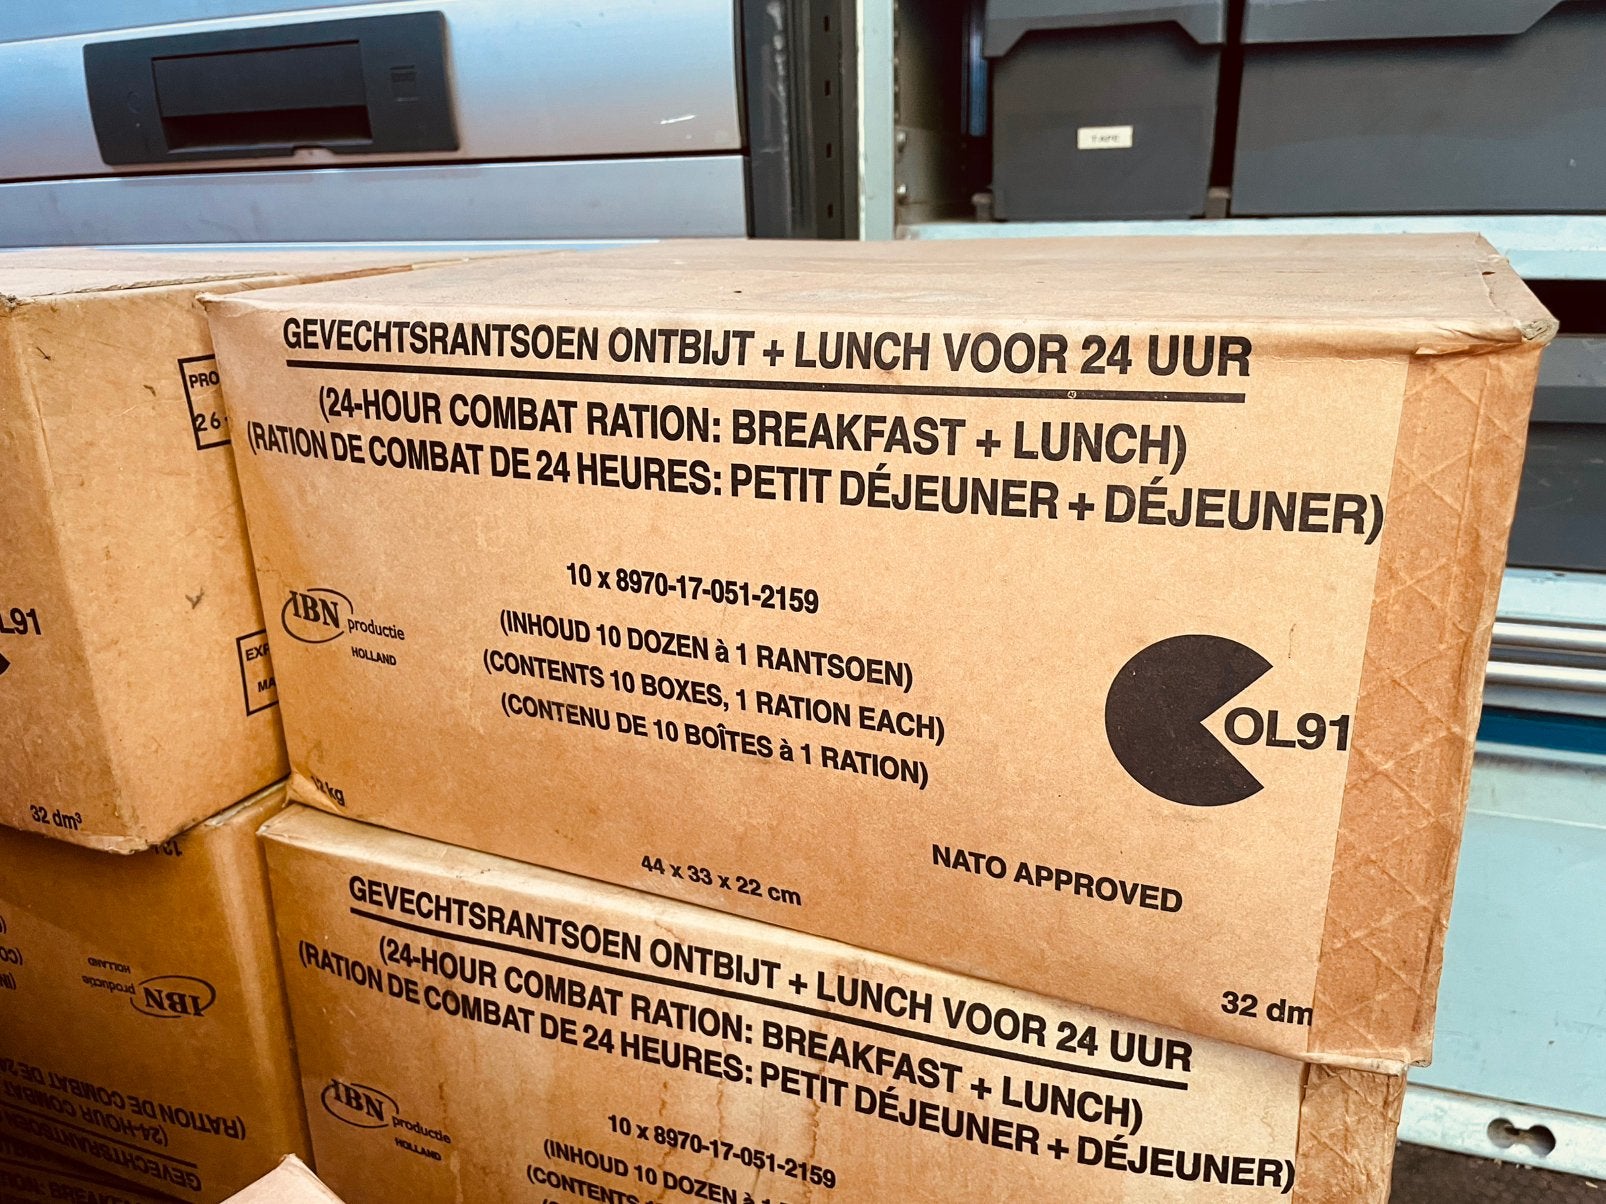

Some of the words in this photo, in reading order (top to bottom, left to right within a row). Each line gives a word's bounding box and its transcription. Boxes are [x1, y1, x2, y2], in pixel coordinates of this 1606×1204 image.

[283, 317, 598, 360] GEVECHTSRANTSOEN
[608, 327, 754, 366] ONTBIJT
[763, 338, 784, 366] +
[796, 331, 930, 371] LUNCH
[943, 333, 1066, 374] VOOR
[1081, 335, 1132, 375] 24
[1147, 335, 1252, 377] UUR
[319, 386, 441, 424] (24-HOUR
[449, 393, 577, 433] COMBAT
[587, 402, 721, 443] RATION:
[732, 409, 966, 455] BREAKFAST
[976, 429, 1001, 457] +
[1015, 420, 1186, 474] LUNCH)
[247, 420, 329, 460] (RATION
[332, 433, 363, 463] DE
[369, 434, 484, 475] COMBAT
[491, 447, 531, 479] DE
[536, 450, 570, 483] 24
[577, 451, 722, 495] HEURES:
[732, 463, 832, 503] PETIT
[839, 463, 1057, 519] DÉJEUNER
[1069, 493, 1095, 521] +
[1105, 476, 1384, 544] DÉJEUNER)
[567, 563, 591, 587] 10
[597, 572, 611, 590] x
[616, 568, 819, 614] 8970-17-051-2159
[289, 590, 341, 629] IBN
[347, 617, 406, 641] productie
[351, 645, 397, 666] HOLLAND
[500, 609, 590, 643] (INHOUD
[596, 624, 621, 648] 10
[627, 627, 708, 660] DOZEN
[715, 639, 729, 663] à
[735, 643, 745, 665] 1
[756, 644, 912, 692] RANTSOEN)
[483, 648, 605, 688] (CONTENTS
[610, 669, 635, 693] 10
[641, 674, 729, 712] BOXES,
[736, 689, 746, 710] 1
[756, 695, 851, 727] RATION
[859, 707, 944, 746] EACH)
[501, 692, 610, 730] (CONTENU
[617, 713, 648, 738] DE
[653, 719, 679, 743] 10
[685, 723, 773, 758] BOÎTES
[779, 738, 794, 762] à
[800, 743, 811, 764] 1
[821, 746, 928, 789] RATION)
[1224, 707, 1350, 751] OL91
[325, 782, 345, 807] kg
[30, 805, 50, 826] 32
[640, 855, 665, 876] 44
[670, 864, 683, 879] x
[687, 864, 713, 885] 33
[718, 874, 731, 890] x
[735, 876, 762, 896] 22
[768, 886, 802, 906] cm
[932, 844, 1006, 879] NATO
[1014, 862, 1182, 913] APPROVED
[82, 975, 136, 995] productie
[87, 957, 131, 974] HOLLAND
[349, 876, 641, 961] GEVECHTSRANTSOEN
[650, 938, 781, 990] ONTBIJT
[789, 972, 808, 995] +
[817, 971, 932, 1024] LUNCH
[943, 997, 1046, 1047] VOOR
[1056, 1021, 1099, 1056] 24
[1110, 1029, 1193, 1072] UUR
[144, 987, 205, 1017] IBN
[1220, 991, 1257, 1018] 32
[379, 935, 496, 988] (24-HOUR
[504, 966, 623, 1017] COMBAT
[631, 994, 753, 1044] RATION:
[762, 1023, 962, 1094] BREAKFAST
[970, 1076, 992, 1099] +
[1002, 1075, 1143, 1135] LUNCH)
[18, 1062, 46, 1086] DE
[299, 939, 383, 993] (RATION
[388, 972, 420, 1005] DE
[424, 984, 535, 1034] COMBAT
[540, 1012, 577, 1046] DE
[582, 1023, 615, 1054] 24
[621, 1030, 753, 1084] HEURES:
[760, 1063, 848, 1107] PETIT
[853, 1084, 1039, 1156] DÉJEUNER
[1047, 1137, 1069, 1161] +
[1077, 1133, 1295, 1194] DÉJEUNER)
[3, 1080, 77, 1117] COMBAT
[48, 1071, 126, 1109] COMBAT
[128, 1095, 157, 1119] DE
[330, 1079, 385, 1122] IBN
[81, 1104, 168, 1147] (24-HOUR
[160, 1104, 246, 1140] (RATION
[392, 1114, 451, 1145] productie
[394, 1137, 442, 1162] HOLLAND
[608, 1114, 631, 1136] 10
[636, 1124, 649, 1140] x
[654, 1125, 836, 1189] 8970-17-051-2159
[527, 1164, 639, 1204] (CONTENTS
[544, 1139, 628, 1177] (INHOUD
[634, 1165, 657, 1185] 10
[663, 1171, 736, 1204] DOZEN
